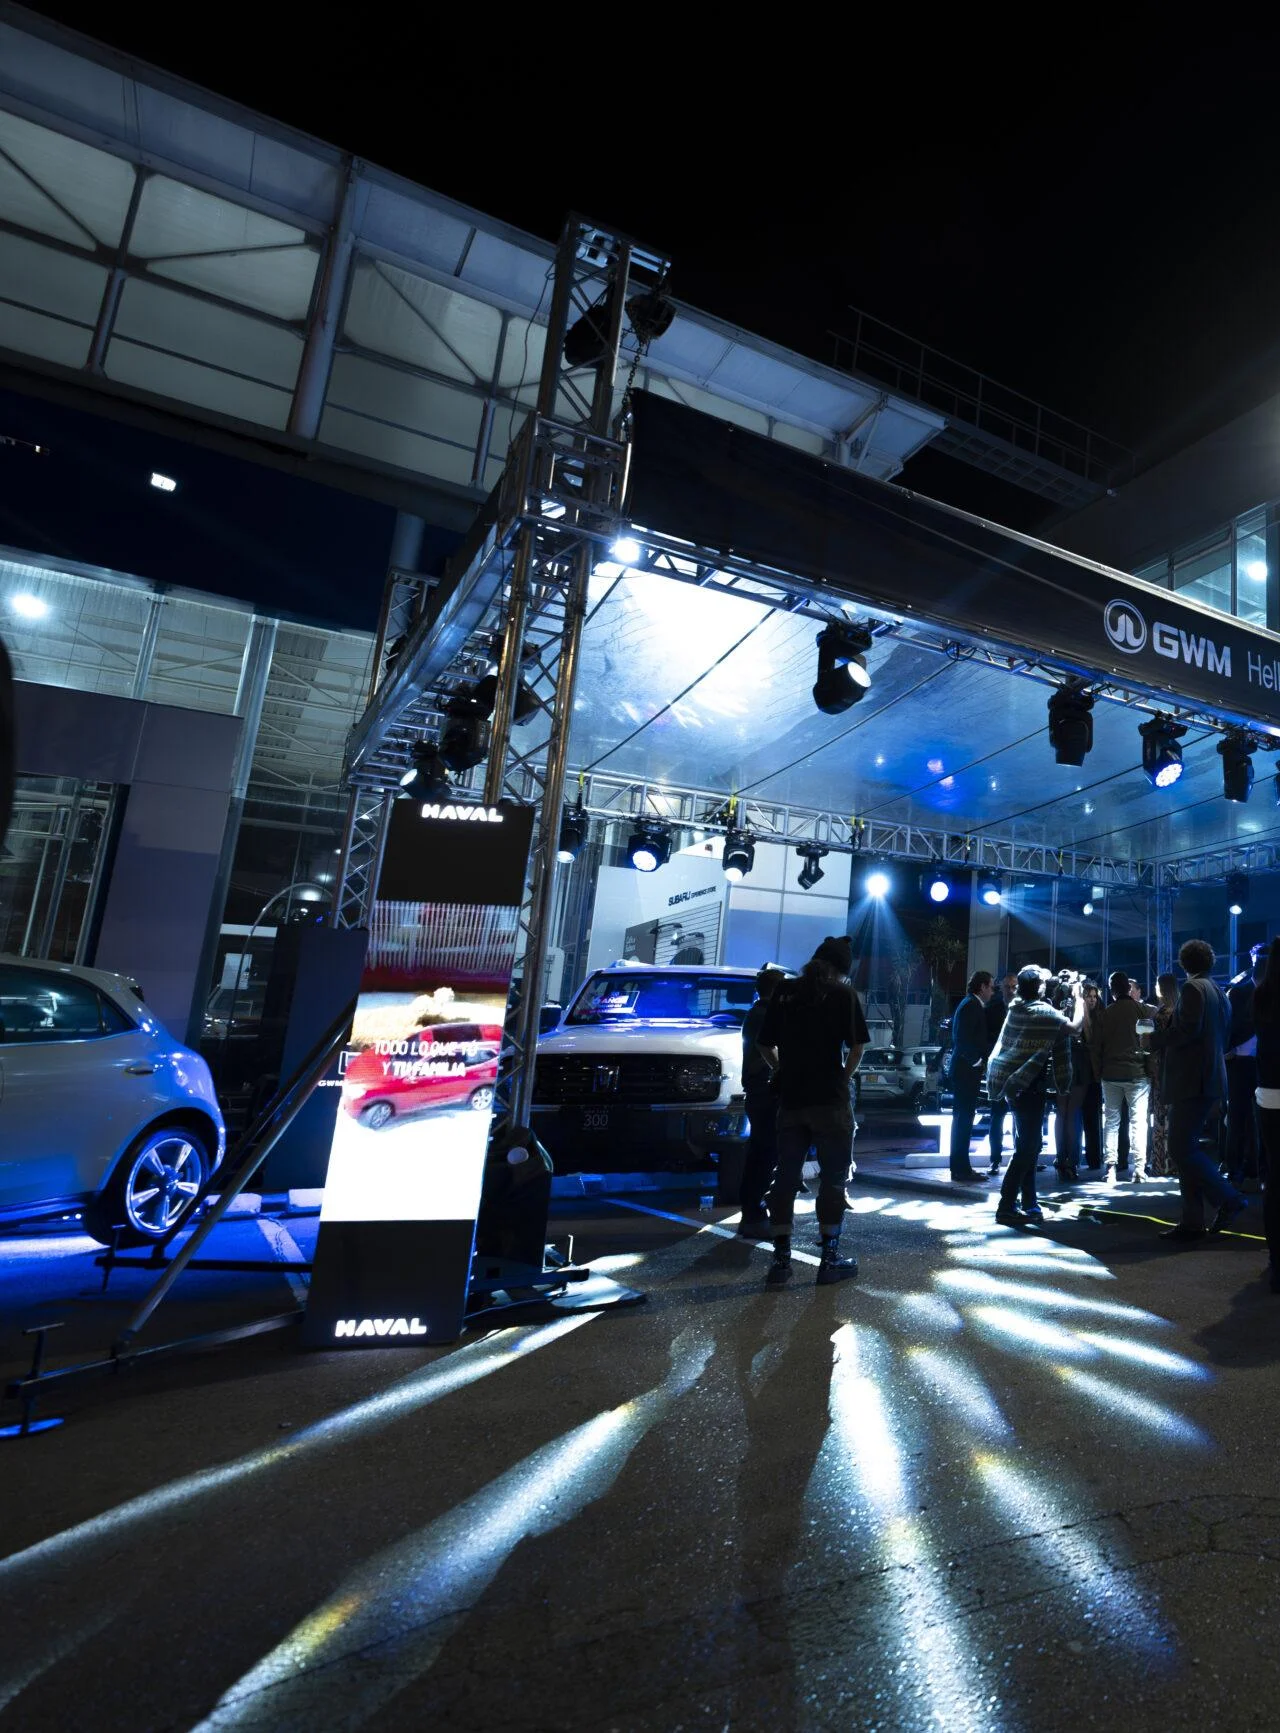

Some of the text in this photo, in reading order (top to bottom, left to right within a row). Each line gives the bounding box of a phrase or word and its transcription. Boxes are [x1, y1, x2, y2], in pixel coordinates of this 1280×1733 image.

[1153, 620, 1232, 677] GWM
[421, 803, 503, 822] HAVAL
[668, 891, 691, 906] SUBARU
[374, 1040, 408, 1055] TODO
[411, 1041, 429, 1056] LO
[430, 1042, 456, 1056] QUE
[382, 1061, 466, 1077] Y TU FAMILIA
[584, 1114, 609, 1127] 300
[334, 1317, 427, 1337] HAVAL
